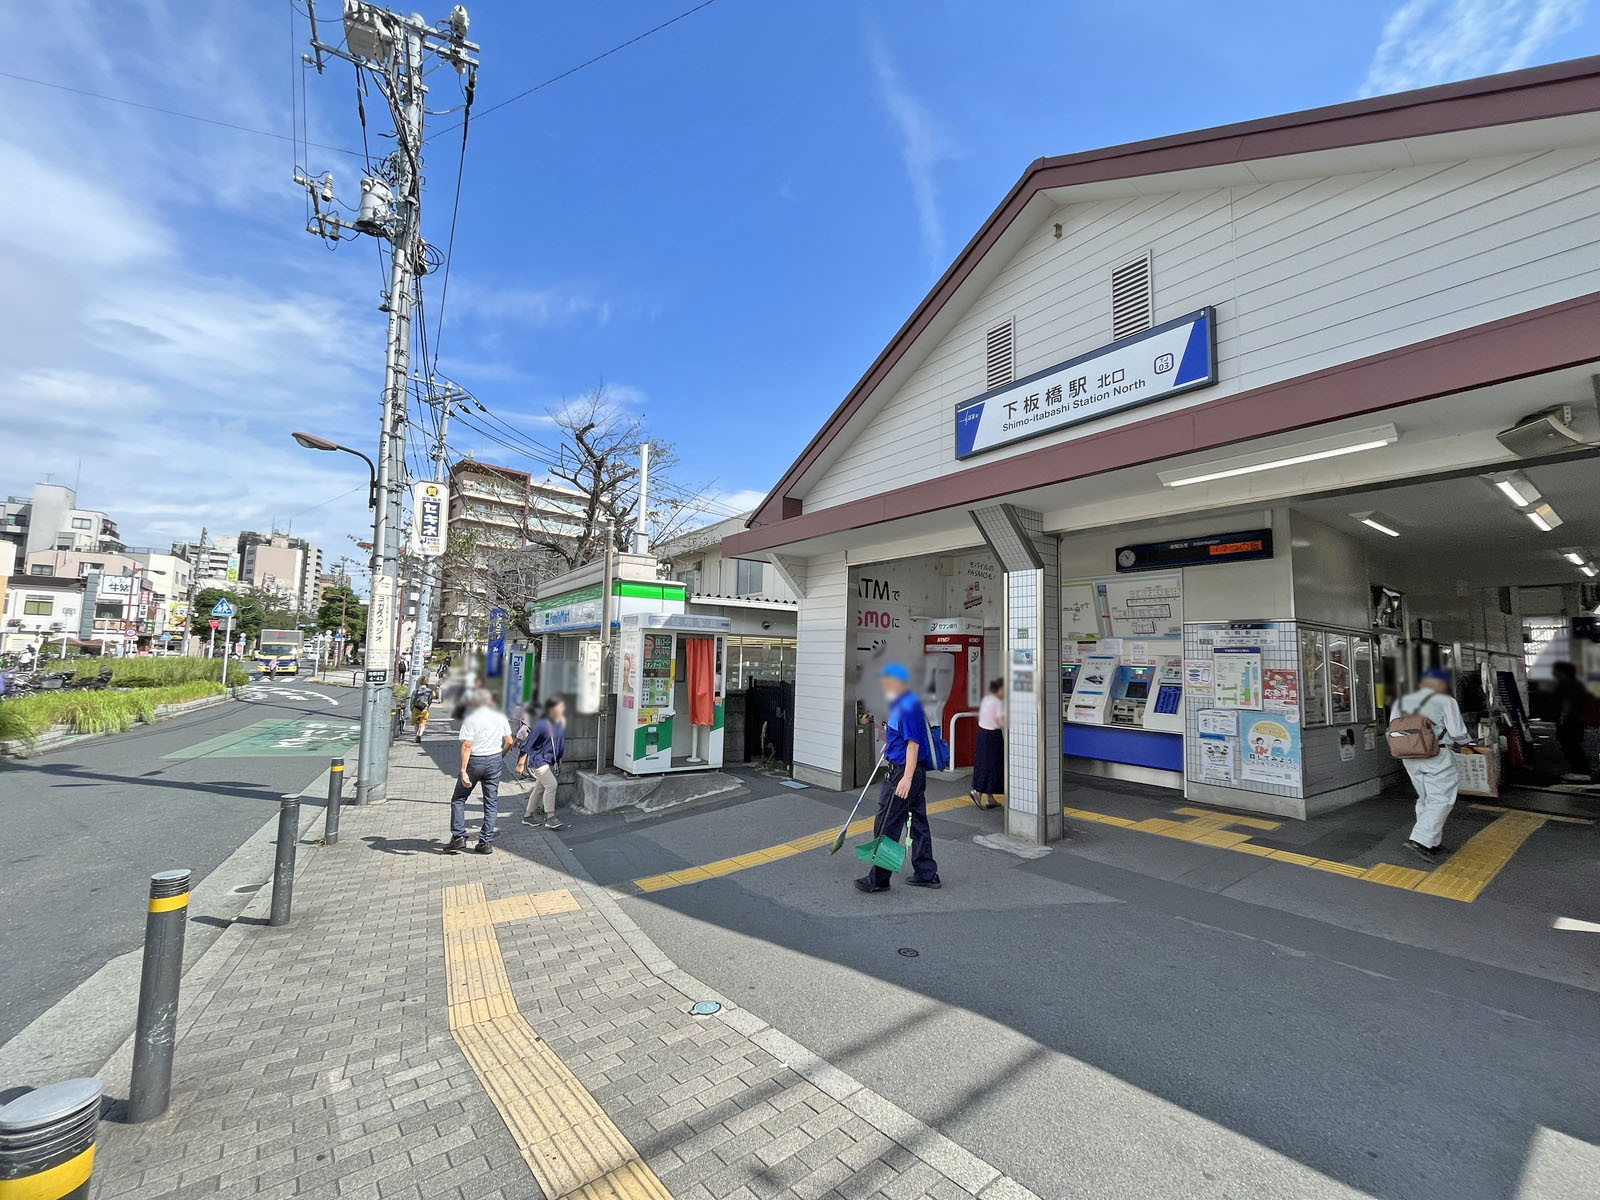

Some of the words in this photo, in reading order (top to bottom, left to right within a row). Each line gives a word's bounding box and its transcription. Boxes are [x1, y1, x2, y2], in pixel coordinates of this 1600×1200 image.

[1158, 362, 1170, 372] 03
[1002, 404, 1070, 432] Shimo-itabashi
[1072, 390, 1110, 409] Station
[1113, 378, 1146, 396] North
[1003, 376, 1087, 419] 下板橋駅
[1097, 368, 1125, 389] 北口
[423, 502, 439, 536] セキネ
[970, 561, 995, 572] モバイルの
[375, 595, 386, 642] ヨガスタジオ
[550, 610, 570, 625] FamilyMart
